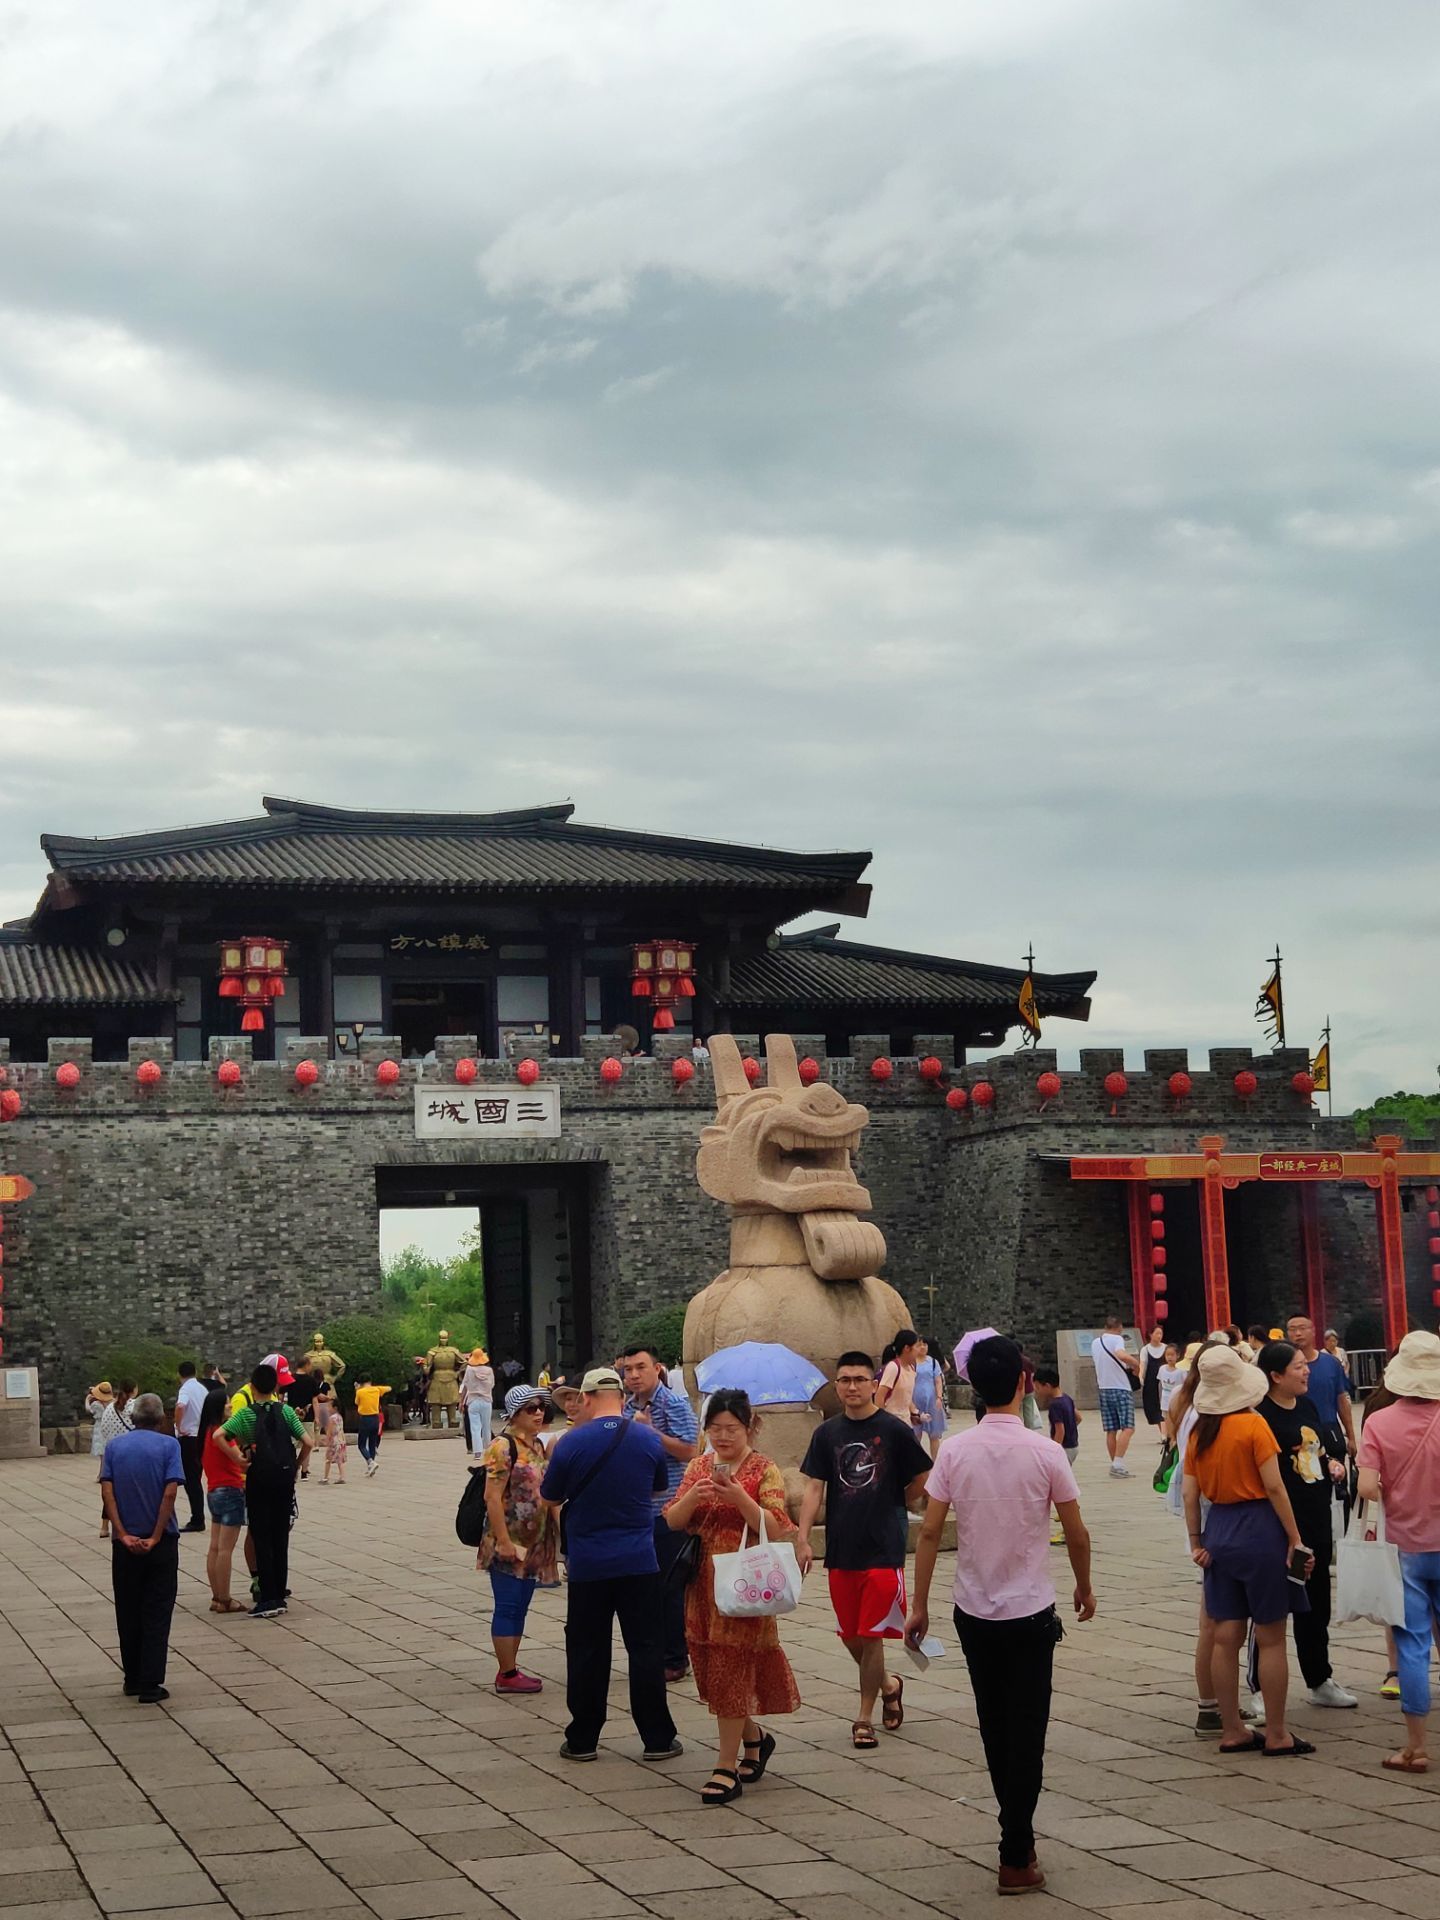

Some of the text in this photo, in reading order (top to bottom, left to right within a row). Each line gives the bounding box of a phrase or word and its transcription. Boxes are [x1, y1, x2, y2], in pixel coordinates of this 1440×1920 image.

[1260, 1158, 1341, 1173] 一部经典一座城
